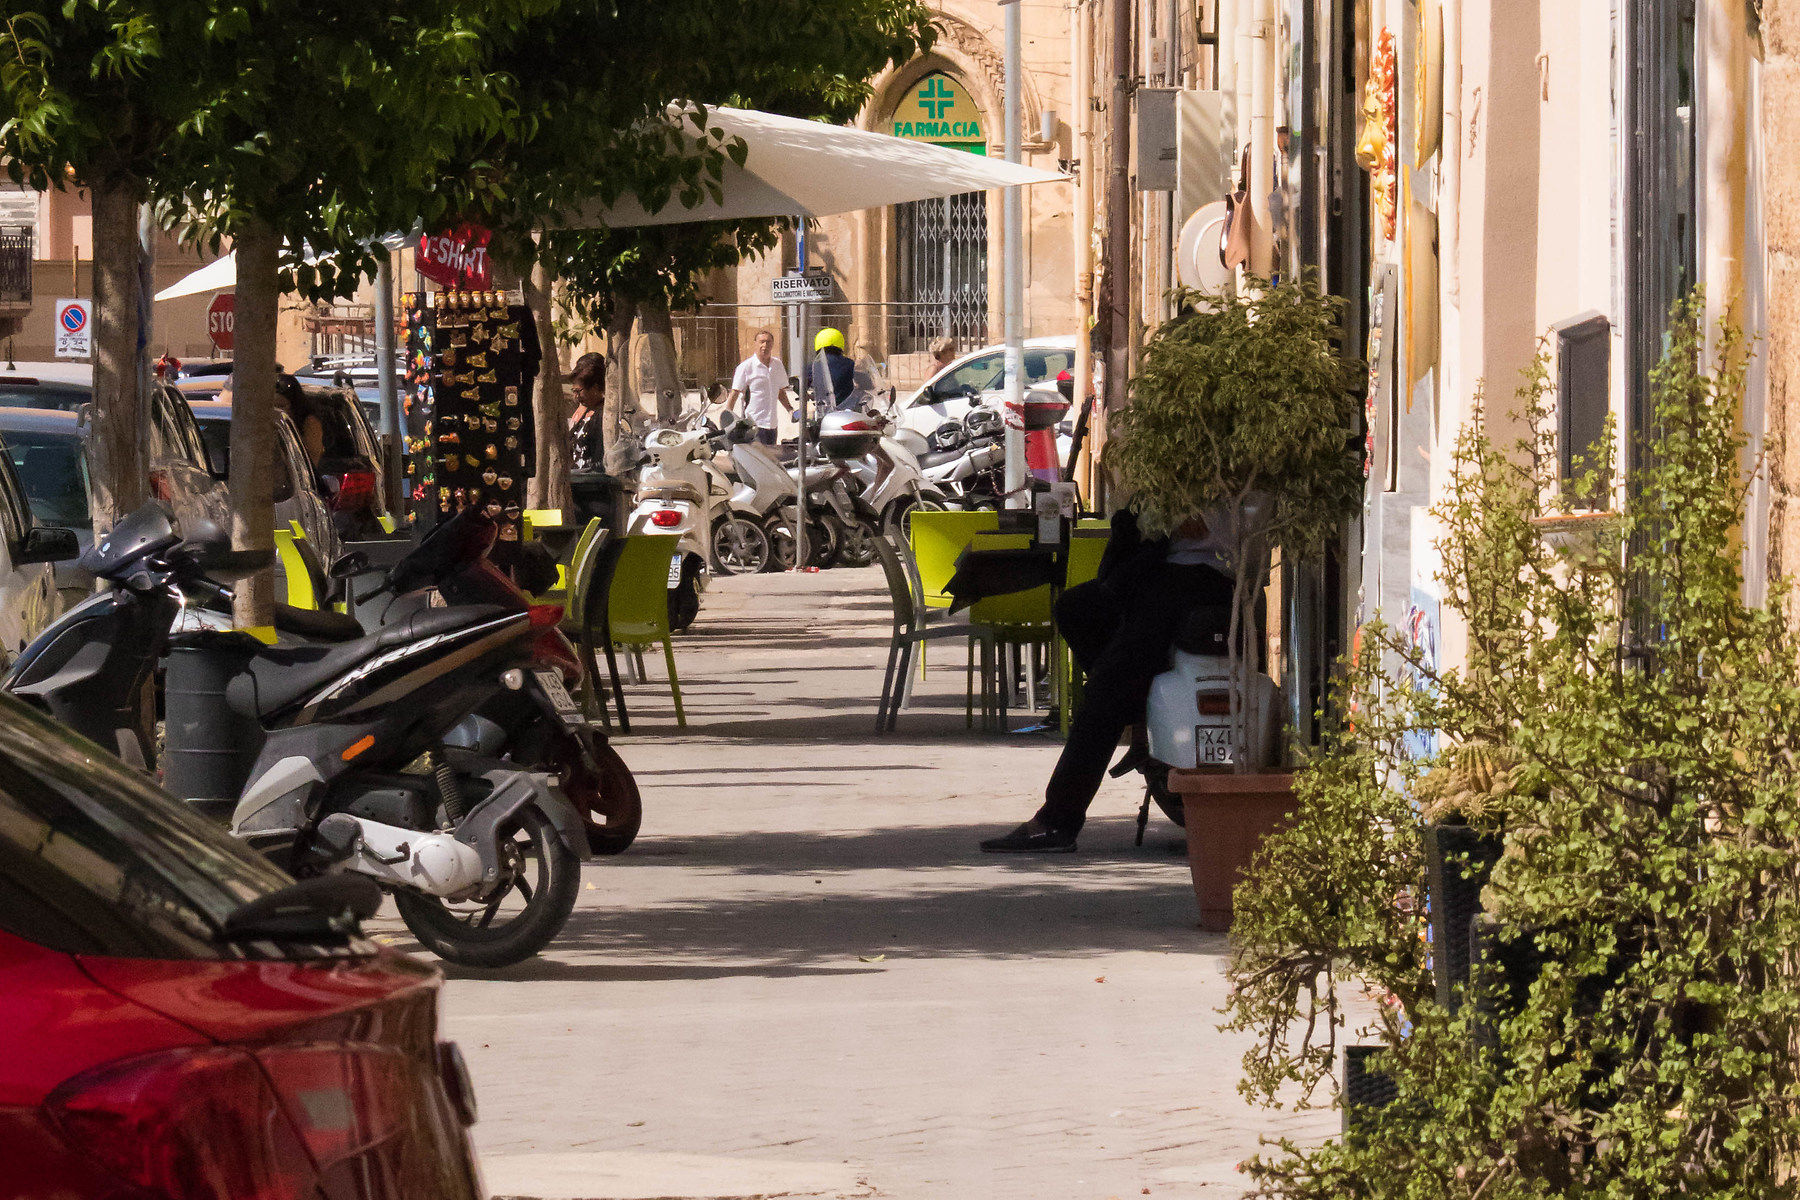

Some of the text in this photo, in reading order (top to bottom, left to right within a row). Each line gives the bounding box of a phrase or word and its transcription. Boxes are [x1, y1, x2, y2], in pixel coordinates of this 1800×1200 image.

[894, 121, 981, 138] FARMACIA
[773, 277, 830, 289] RISERVATO
[210, 311, 235, 333] STO
